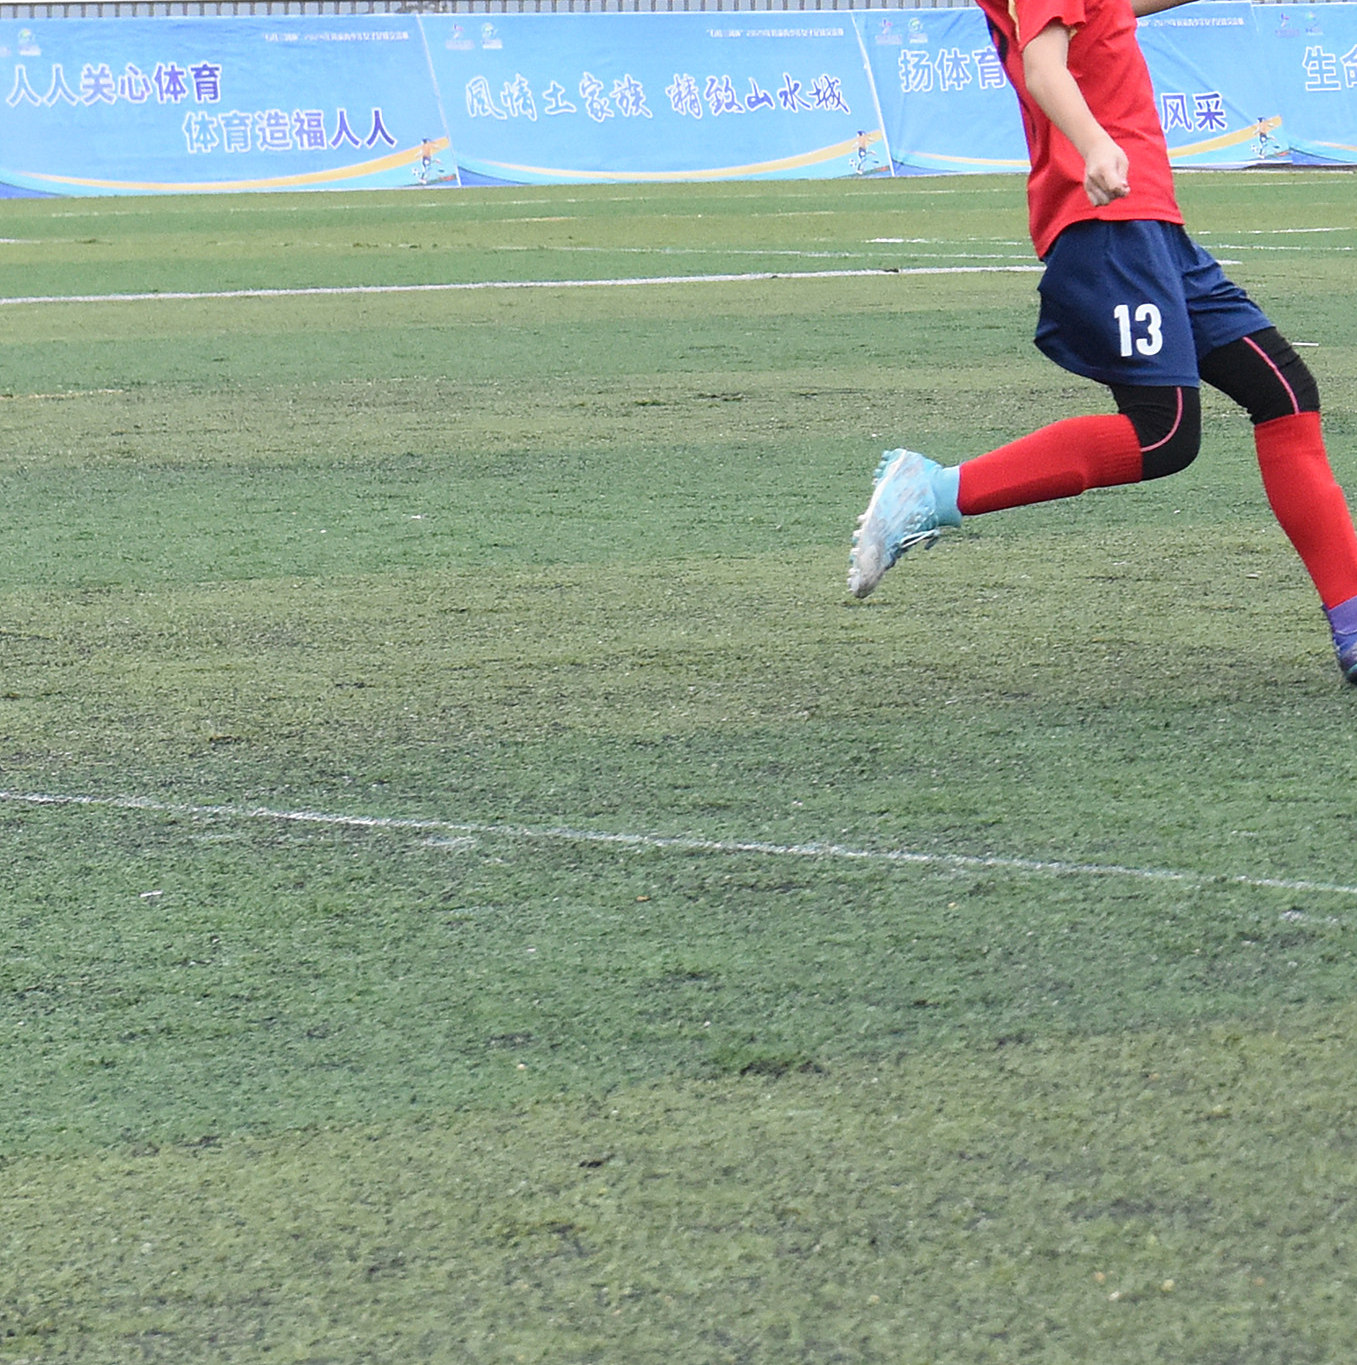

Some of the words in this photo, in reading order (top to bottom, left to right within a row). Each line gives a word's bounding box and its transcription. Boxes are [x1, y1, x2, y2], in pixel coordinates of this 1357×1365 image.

[7, 60, 222, 107] 人人关心体育
[465, 72, 653, 123] 风情土家族
[665, 72, 851, 119] 精致山水城
[182, 109, 397, 153] 体育造福人人
[1161, 91, 1228, 132] 风采
[1113, 303, 1163, 357] 13
